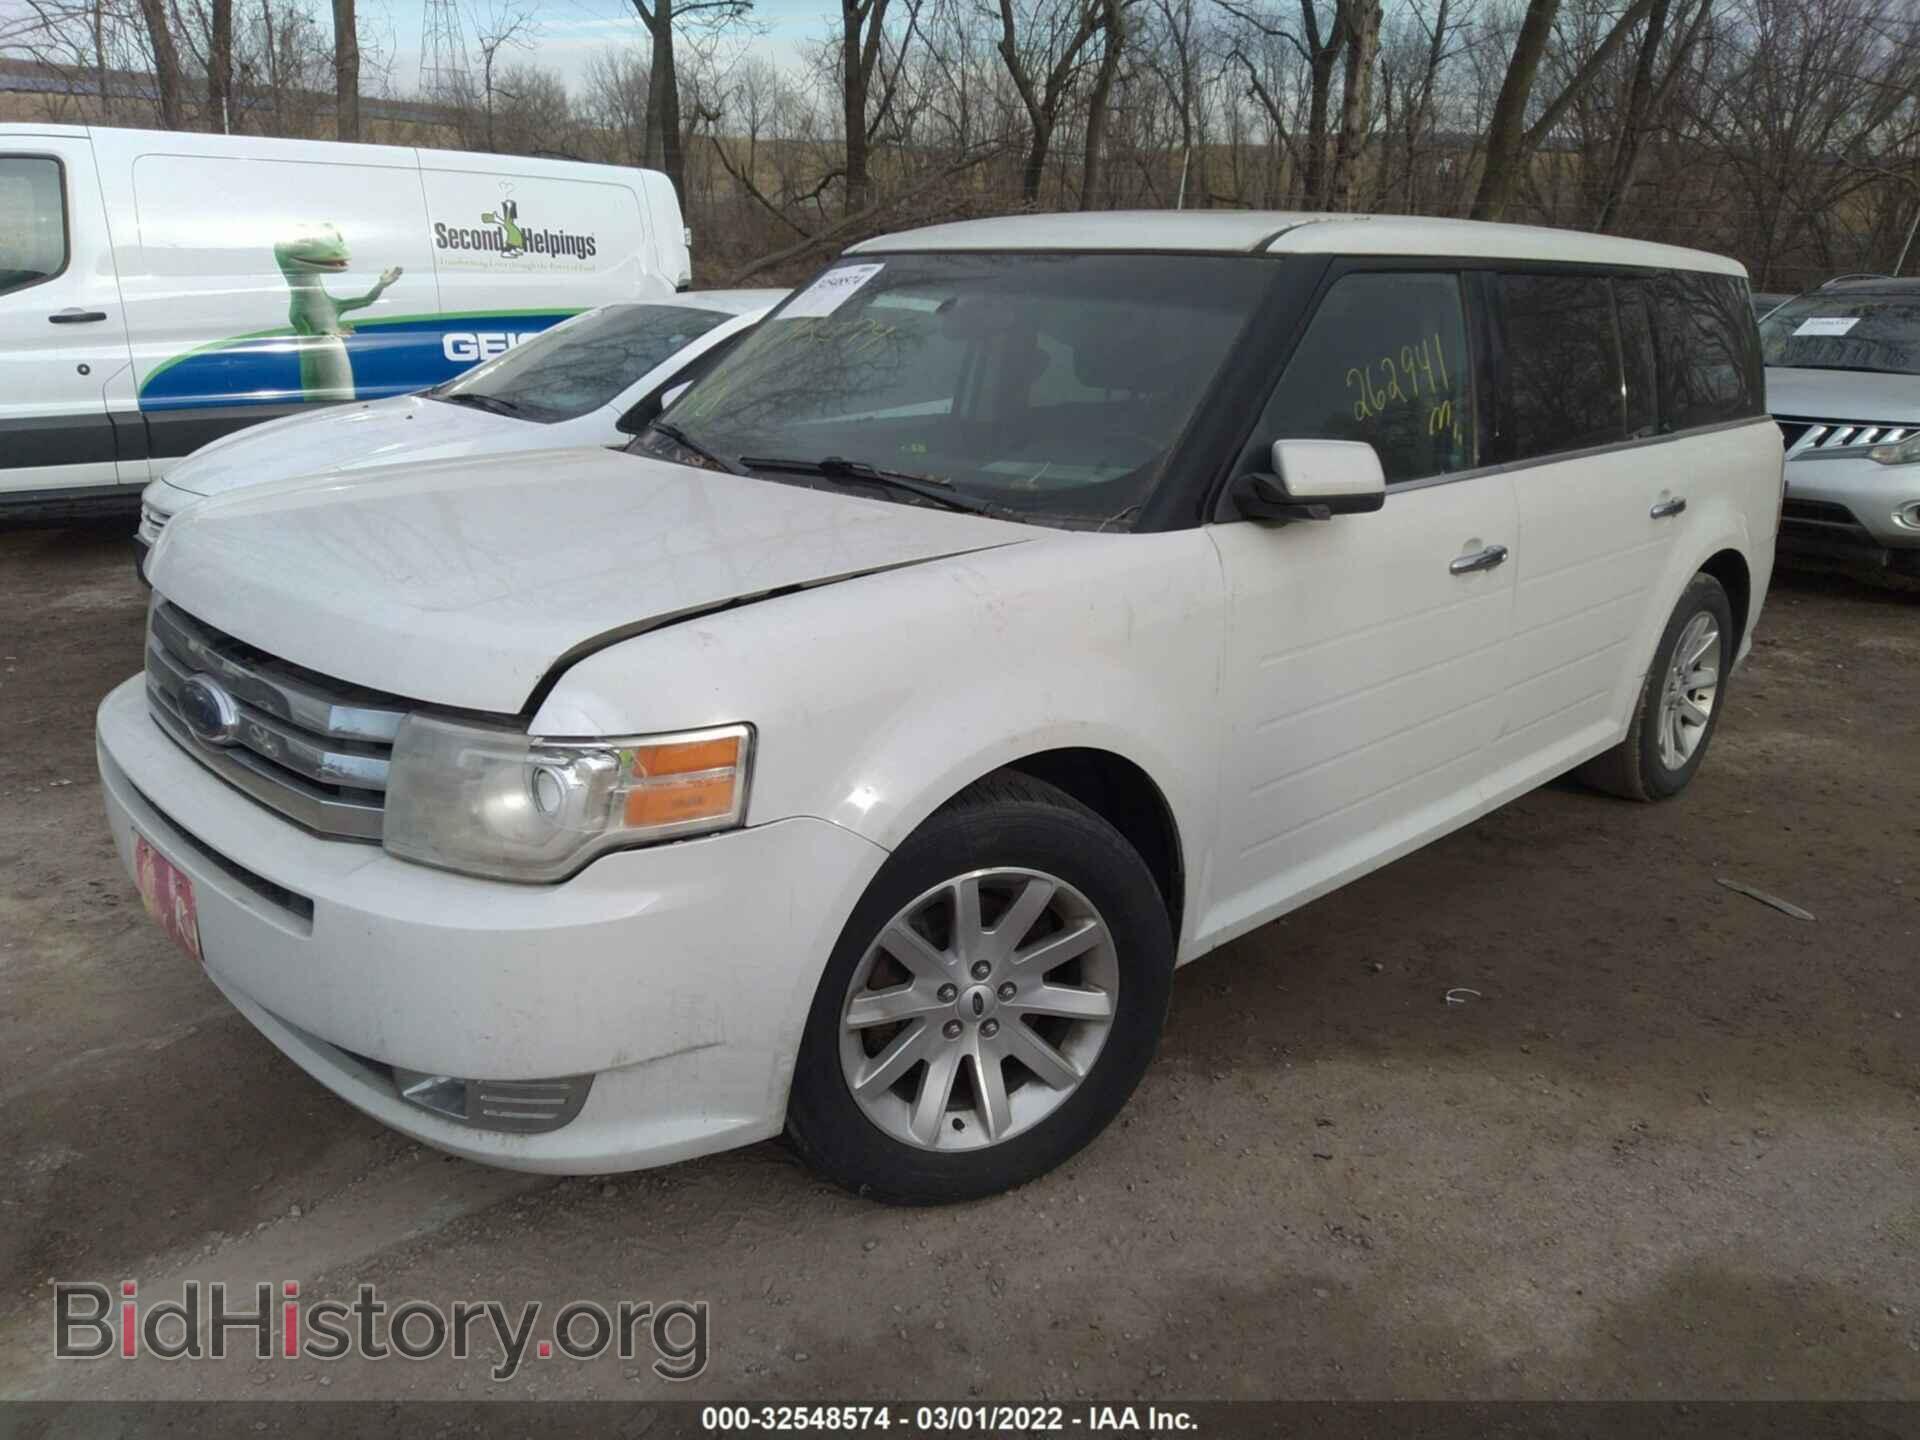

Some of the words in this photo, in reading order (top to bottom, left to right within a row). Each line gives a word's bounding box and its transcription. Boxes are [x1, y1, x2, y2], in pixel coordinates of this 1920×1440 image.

[434, 221, 504, 251] Second
[522, 227, 597, 260] Helpings
[1346, 333, 1449, 421] 262941
